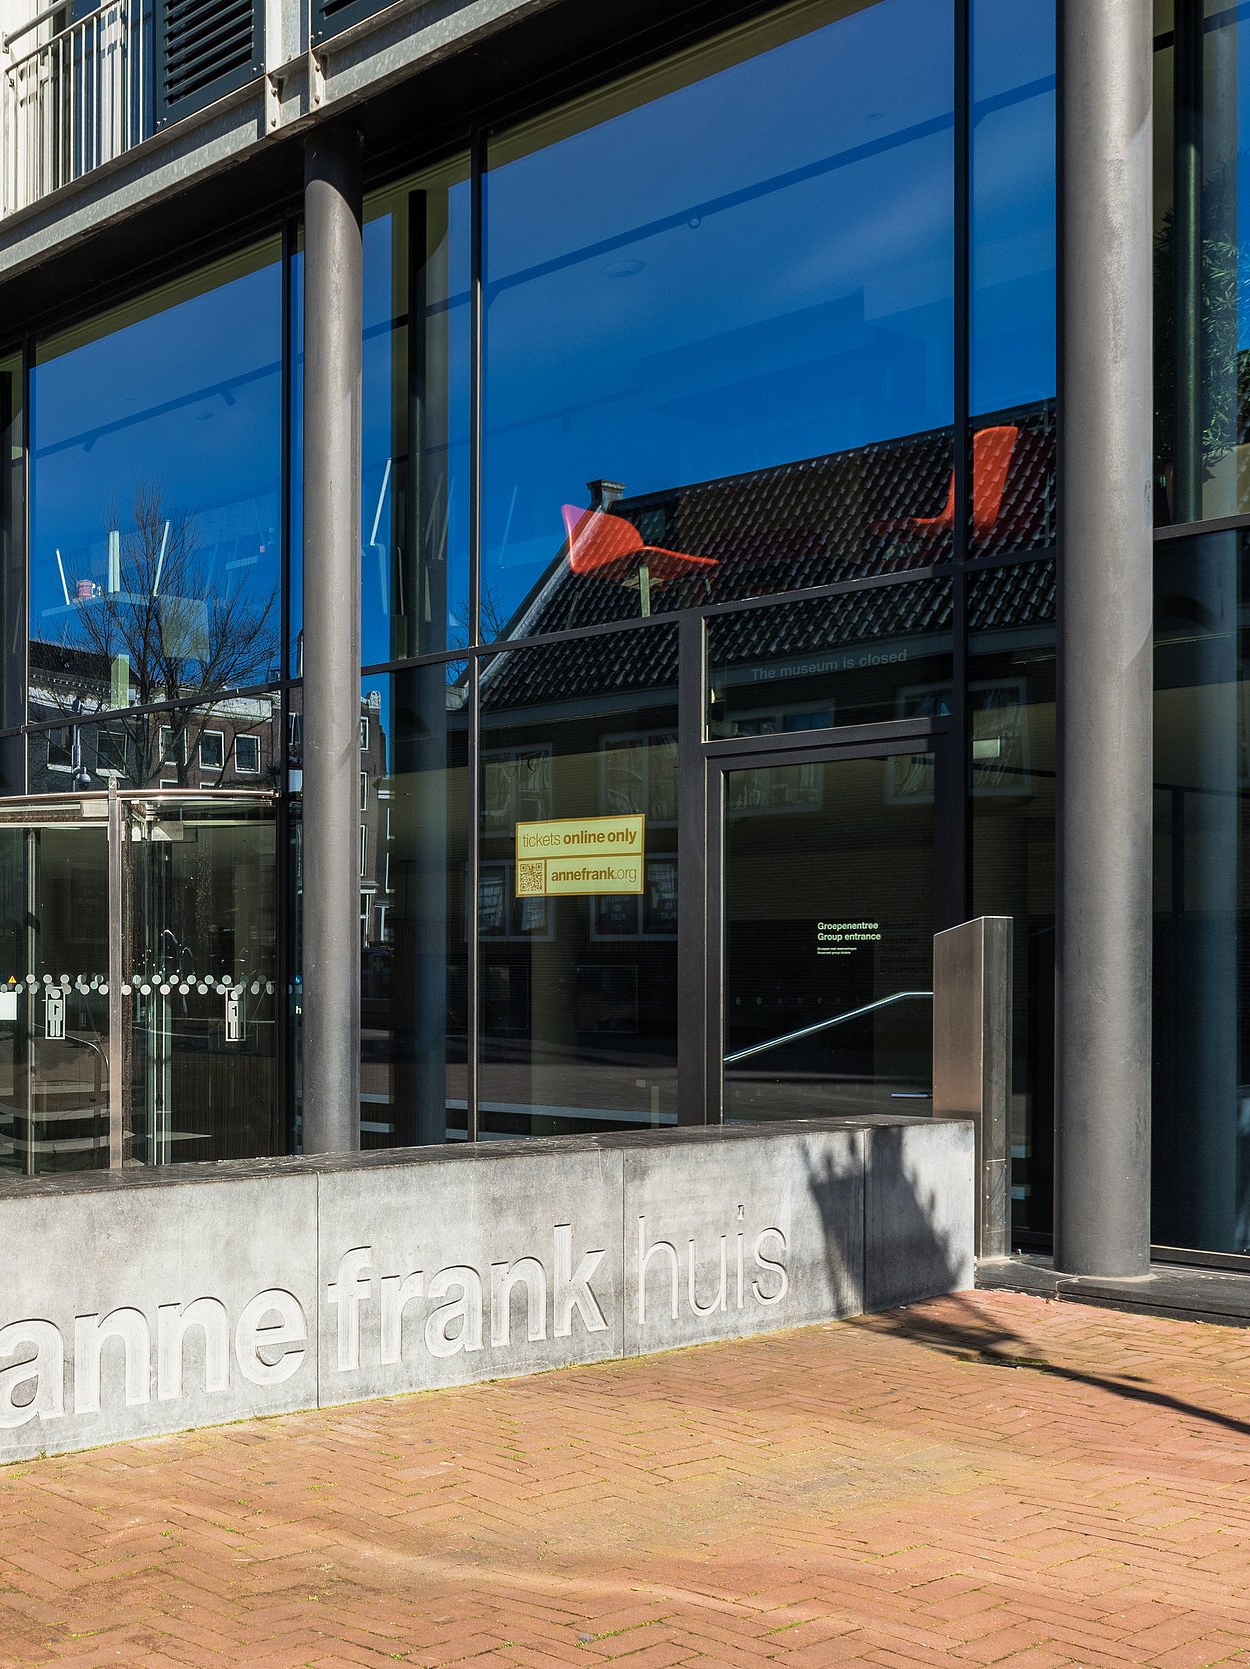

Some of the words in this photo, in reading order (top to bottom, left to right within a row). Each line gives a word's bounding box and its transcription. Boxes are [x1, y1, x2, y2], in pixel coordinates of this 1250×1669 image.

[751, 668, 776, 681] The
[780, 660, 837, 676] museum
[842, 657, 855, 669] is
[859, 649, 907, 667] closed
[522, 832, 561, 848] tickets
[563, 830, 606, 845] online
[607, 828, 638, 844] only
[551, 867, 637, 883] annefrank.org
[817, 922, 879, 931] Groepenentree
[817, 933, 843, 942] Group
[232, 1006, 237, 1016] 1
[327, 1223, 609, 1372] frank
[638, 1205, 789, 1325] huis
